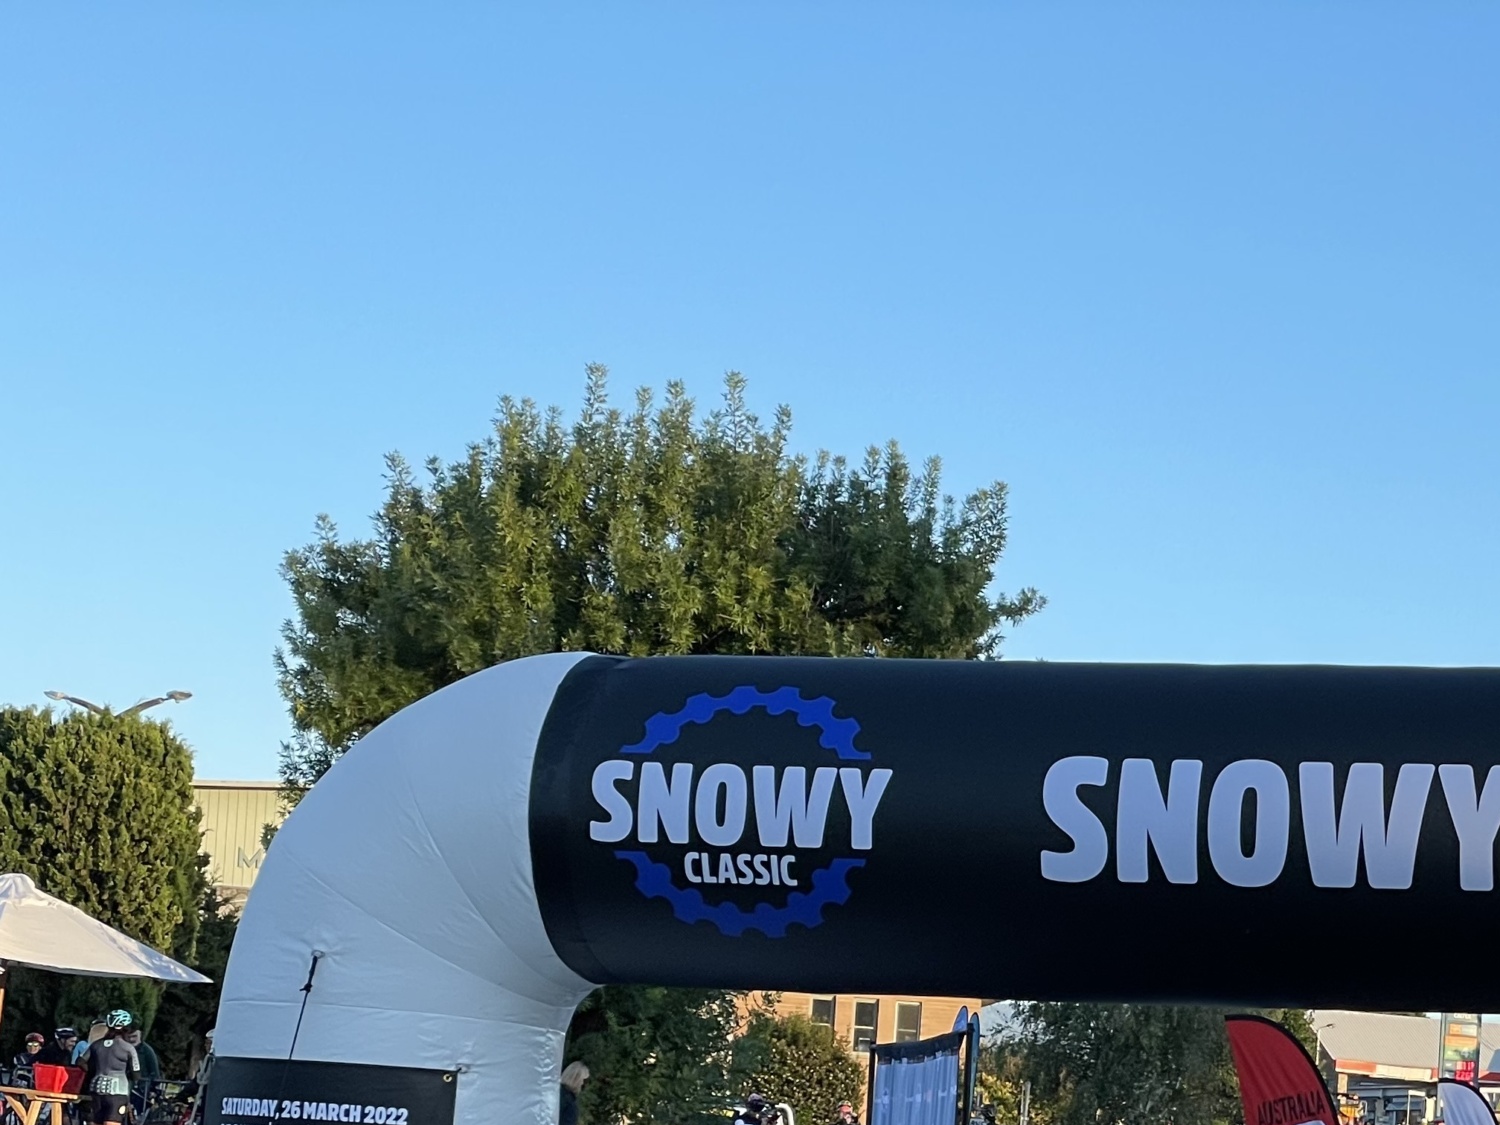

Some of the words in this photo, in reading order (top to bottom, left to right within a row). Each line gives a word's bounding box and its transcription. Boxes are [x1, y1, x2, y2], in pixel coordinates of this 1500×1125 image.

[589, 760, 893, 850] SNOWY
[683, 852, 798, 886] CLASSIC
[221, 1097, 279, 1121] SATURDAY,
[281, 1101, 300, 1119] 26
[303, 1102, 361, 1123] MARCH
[364, 1106, 408, 1125] 2022
